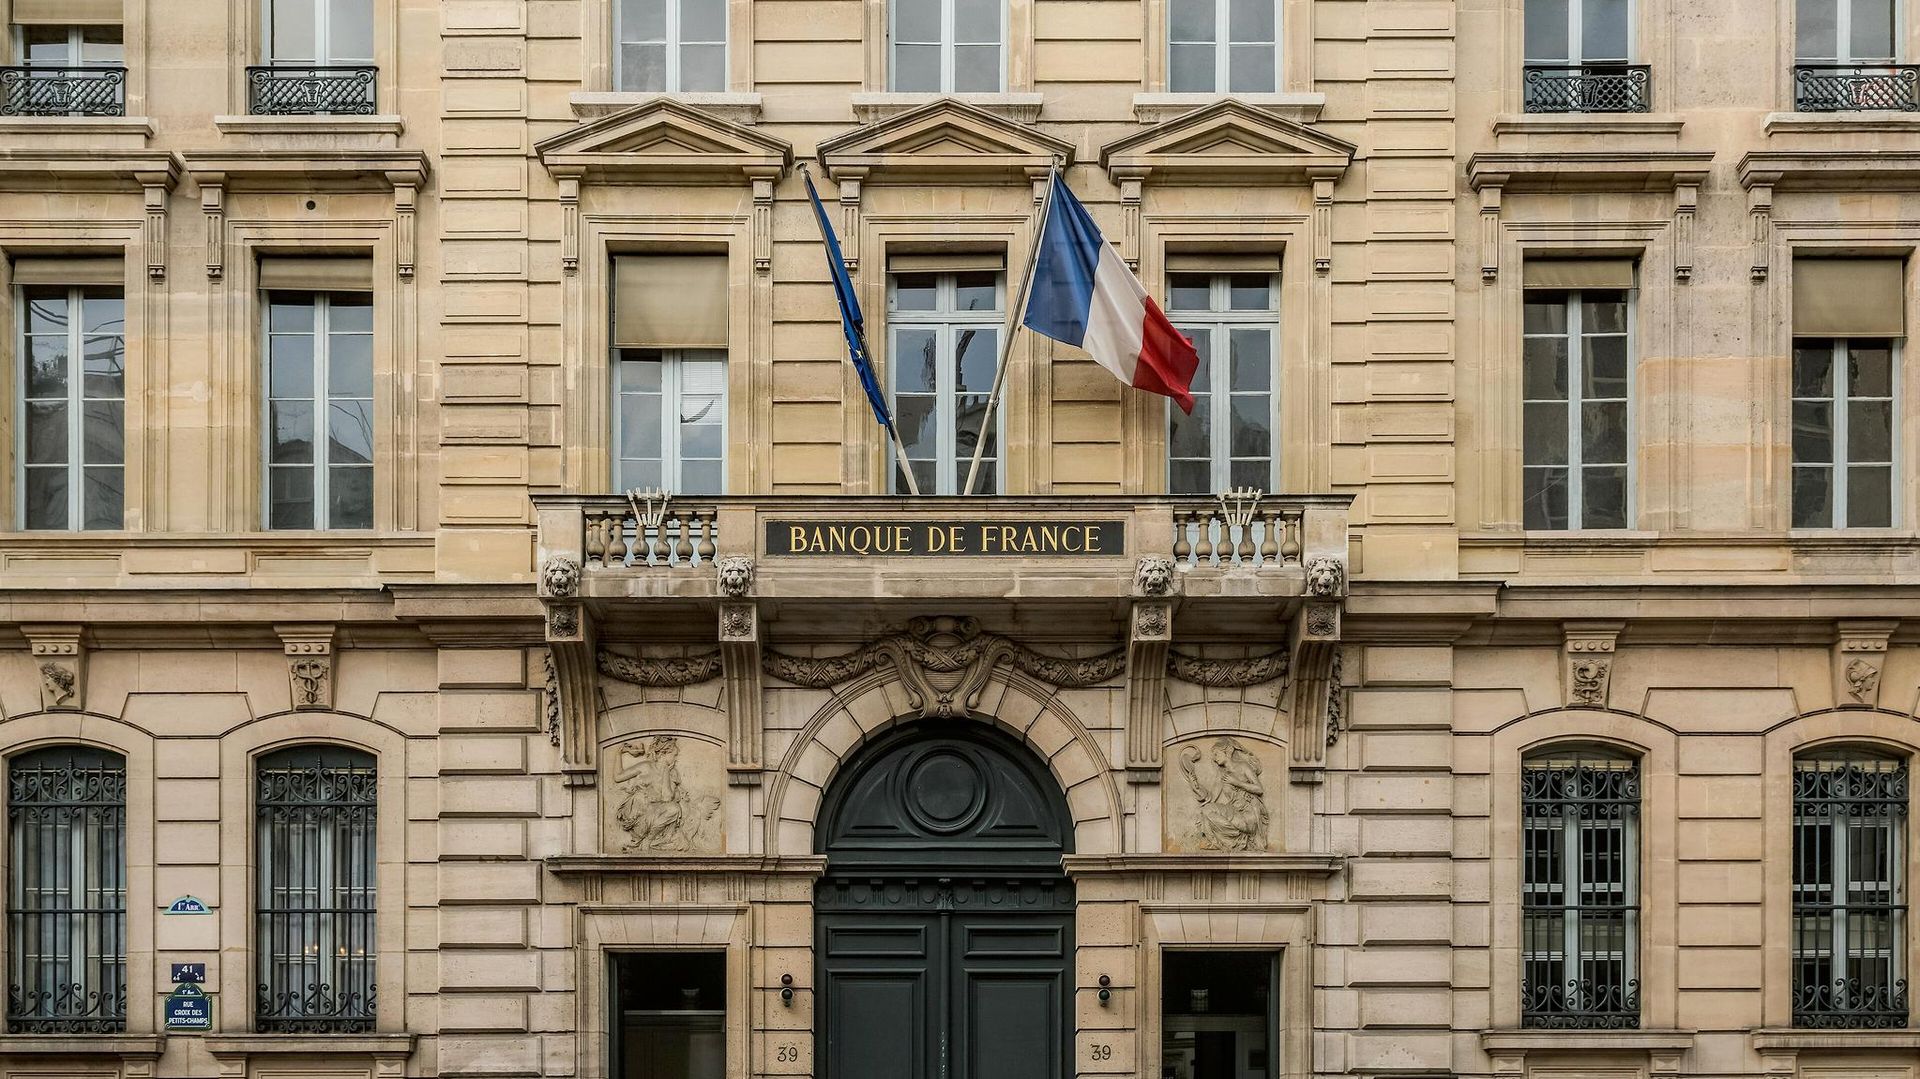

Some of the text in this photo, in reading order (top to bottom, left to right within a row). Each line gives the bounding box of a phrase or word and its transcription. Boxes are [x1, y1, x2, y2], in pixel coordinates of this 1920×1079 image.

[789, 526, 1102, 554] BANQUE DE FRANCE
[181, 965, 193, 973] 41
[777, 1046, 798, 1062] 39
[1091, 1044, 1111, 1060] 39
